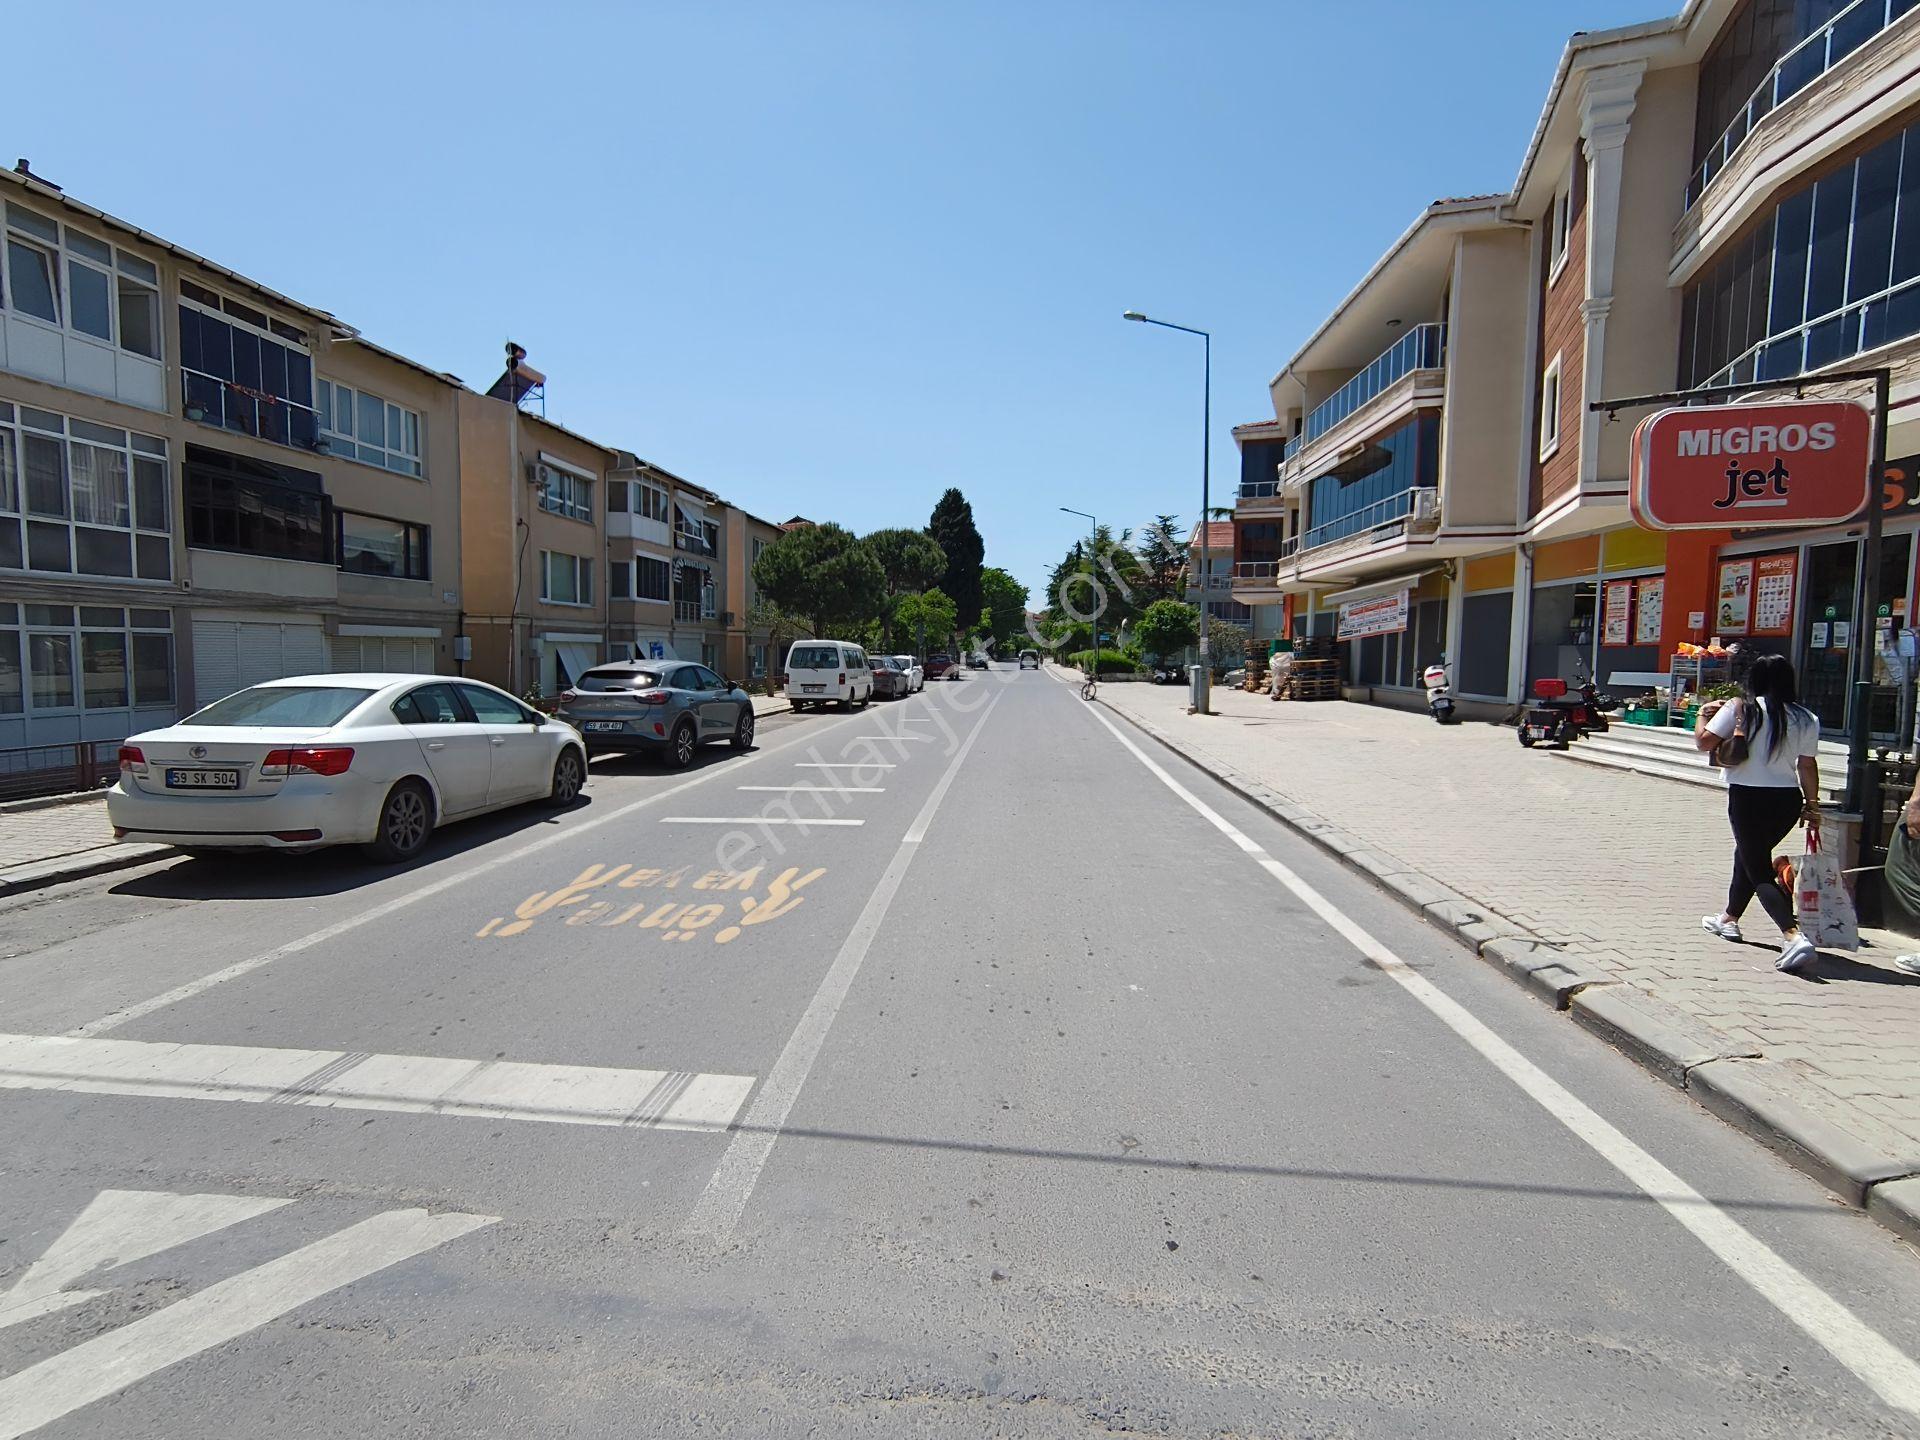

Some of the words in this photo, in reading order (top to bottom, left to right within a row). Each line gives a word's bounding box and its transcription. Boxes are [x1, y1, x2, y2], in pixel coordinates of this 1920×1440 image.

[1712, 456, 1791, 509] jet
[173, 773, 187, 784] 59
[194, 773, 207, 784] SK
[214, 773, 235, 784] 504
